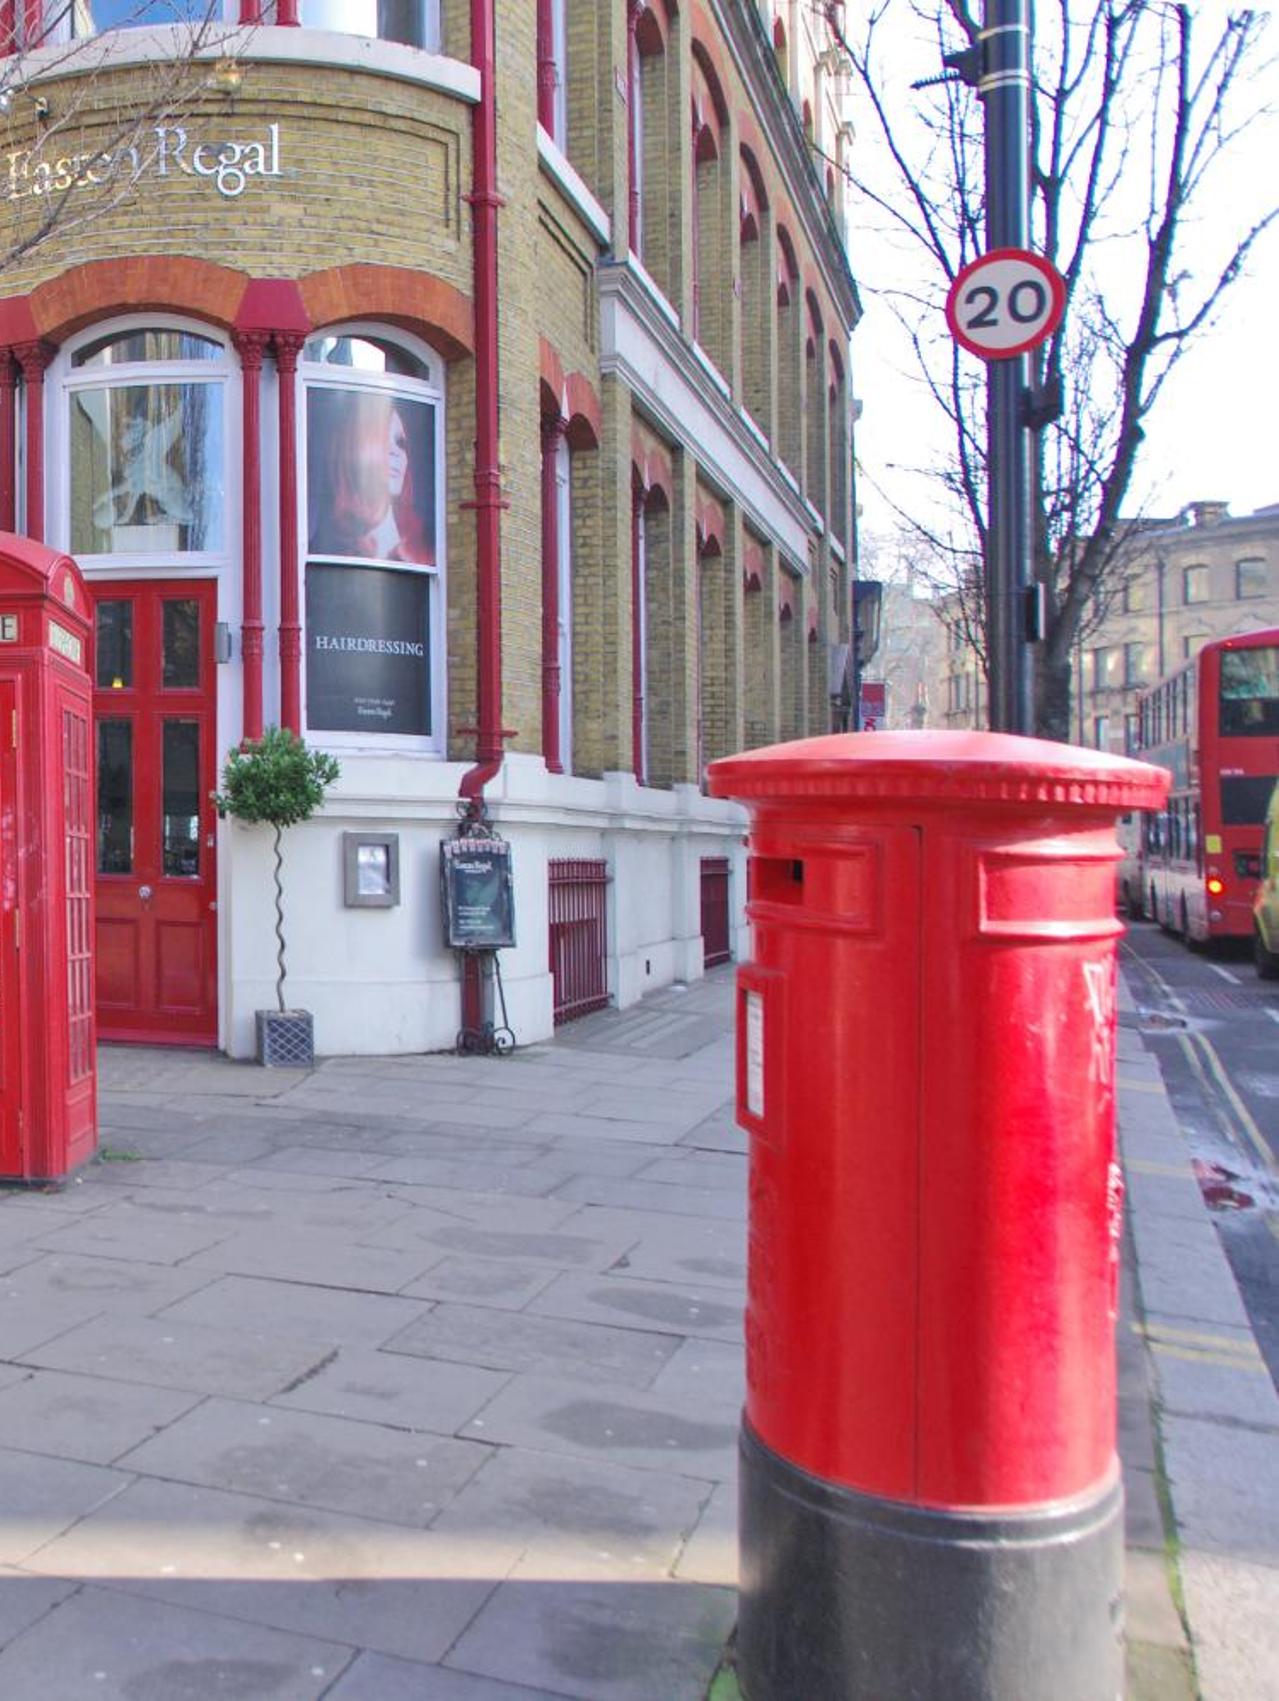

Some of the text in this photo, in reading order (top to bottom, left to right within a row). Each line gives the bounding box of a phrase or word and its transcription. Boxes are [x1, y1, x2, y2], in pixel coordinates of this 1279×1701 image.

[155, 122, 283, 197] Regal
[965, 280, 1046, 330] 20
[315, 636, 425, 656] HAIRDRESSING
